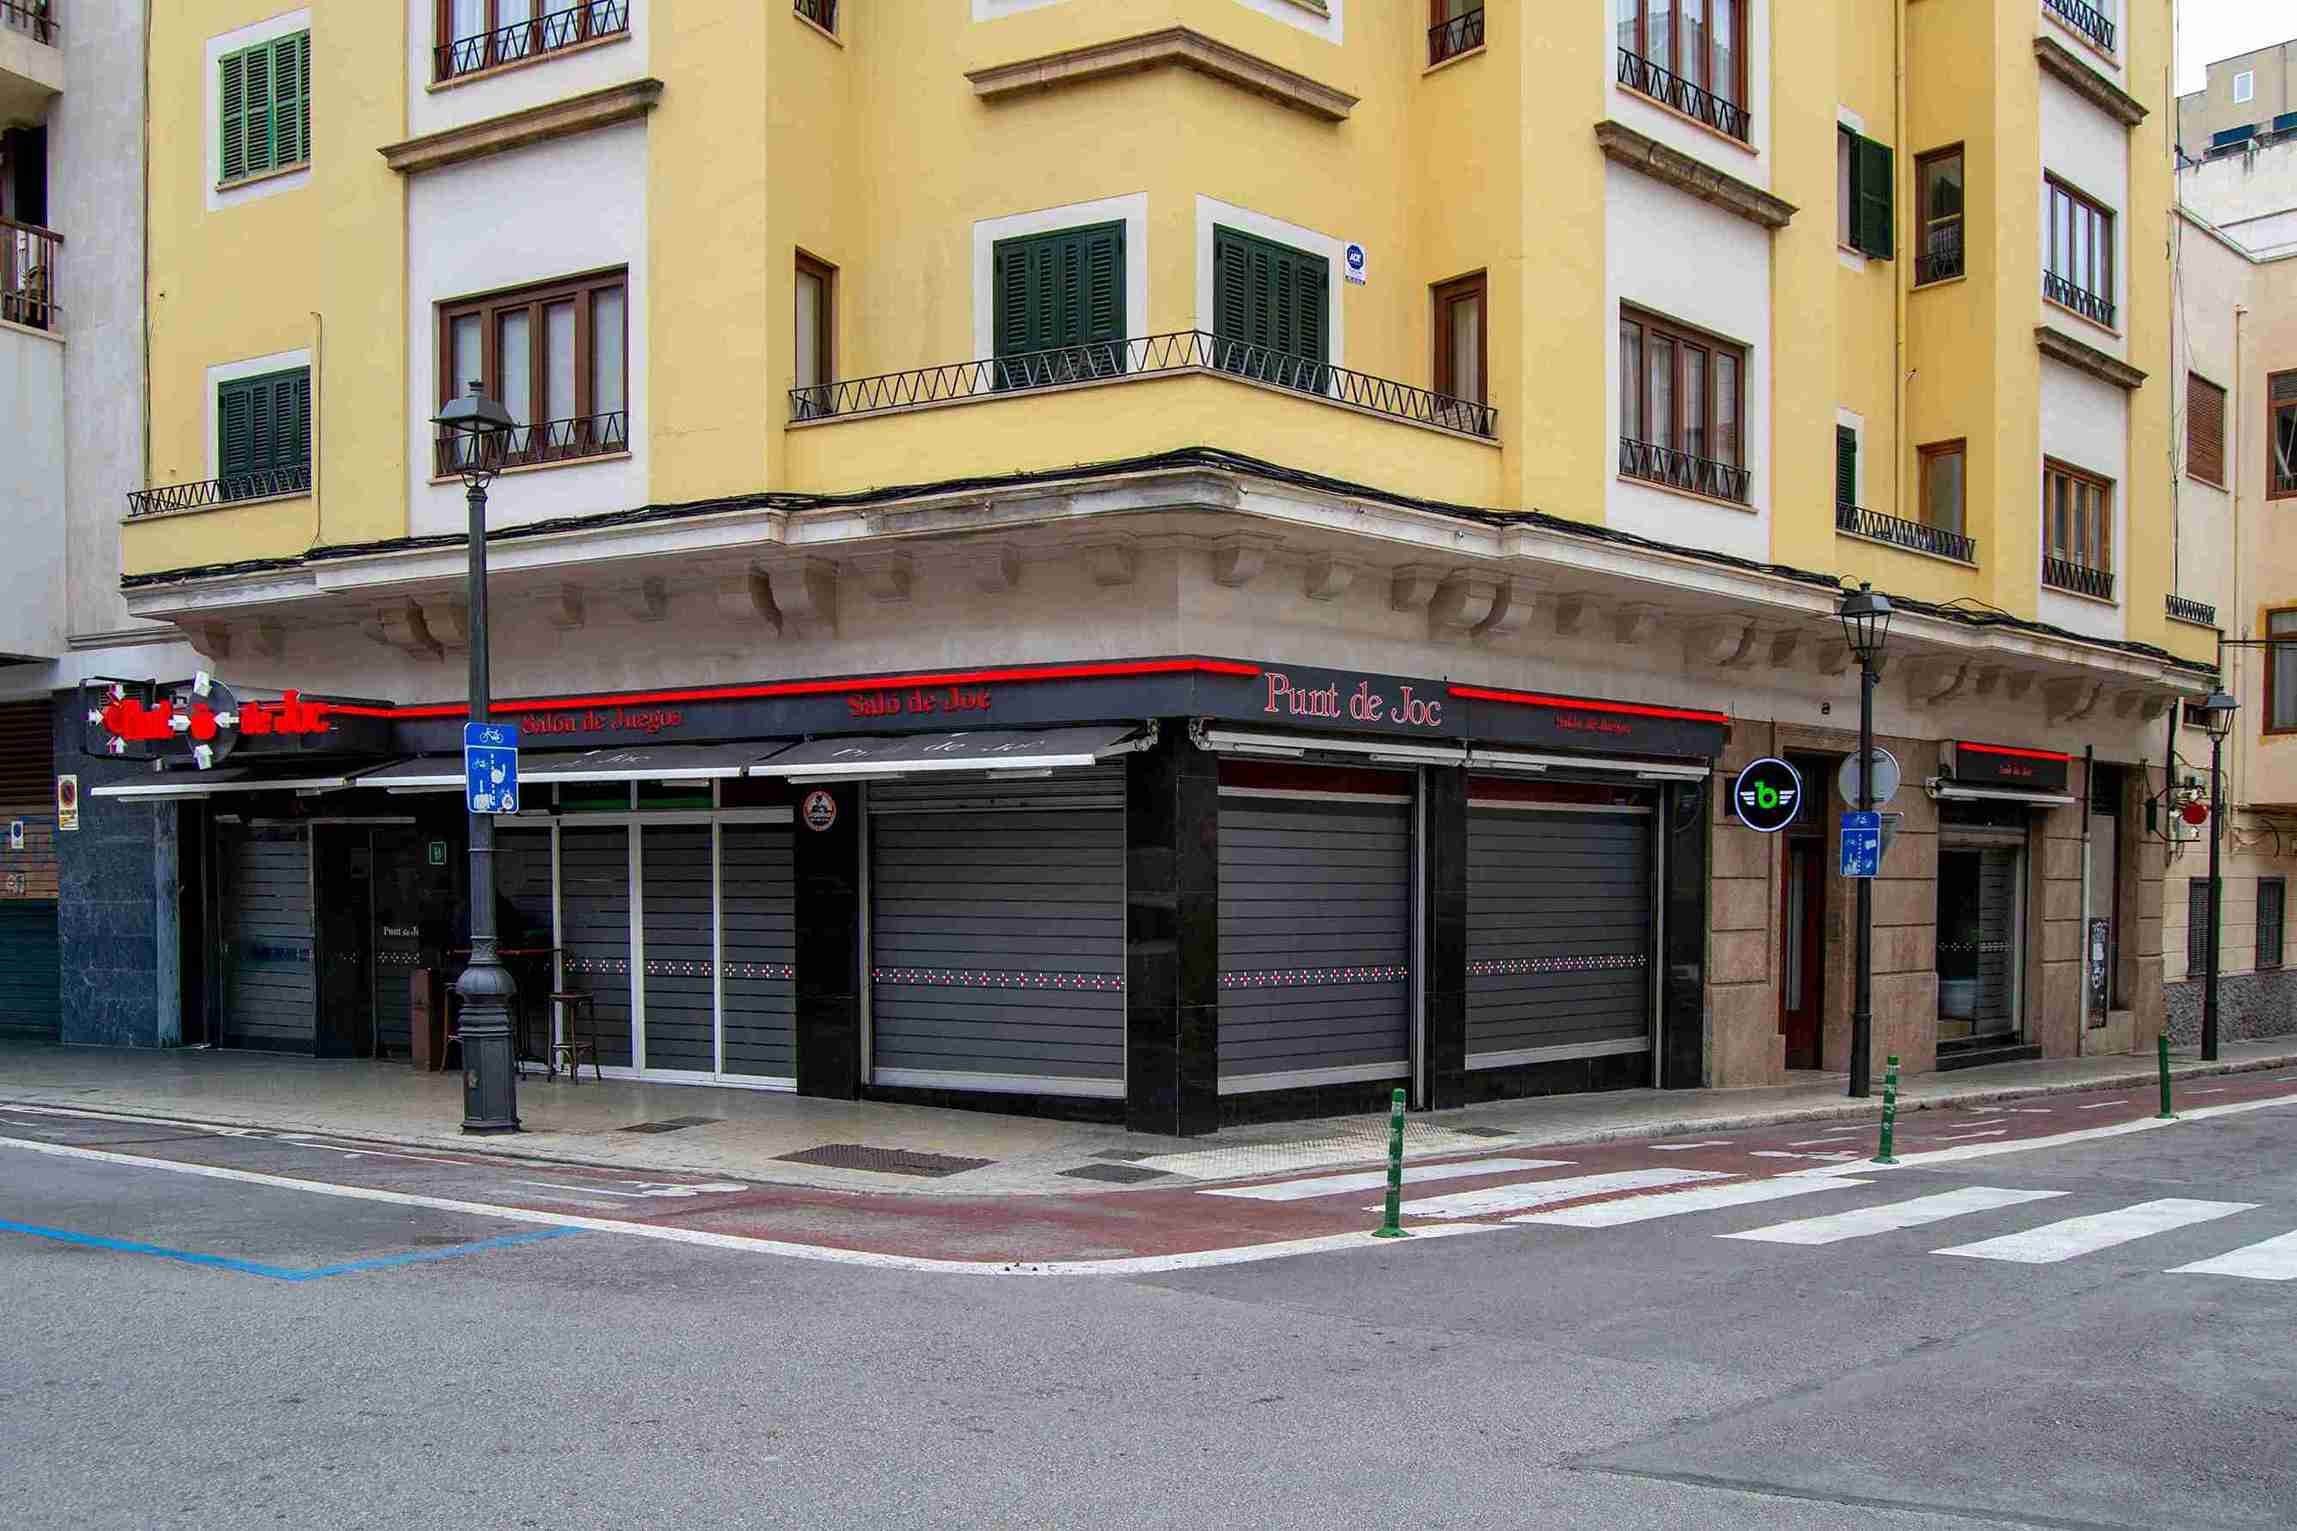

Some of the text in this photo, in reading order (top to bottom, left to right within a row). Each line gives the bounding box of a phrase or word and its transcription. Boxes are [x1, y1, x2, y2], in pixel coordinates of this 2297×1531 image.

[907, 688, 936, 714] de
[944, 687, 992, 711] Joc
[1264, 672, 1442, 727] Punt de Joc
[582, 710, 604, 732] de
[610, 706, 682, 733] Juegos
